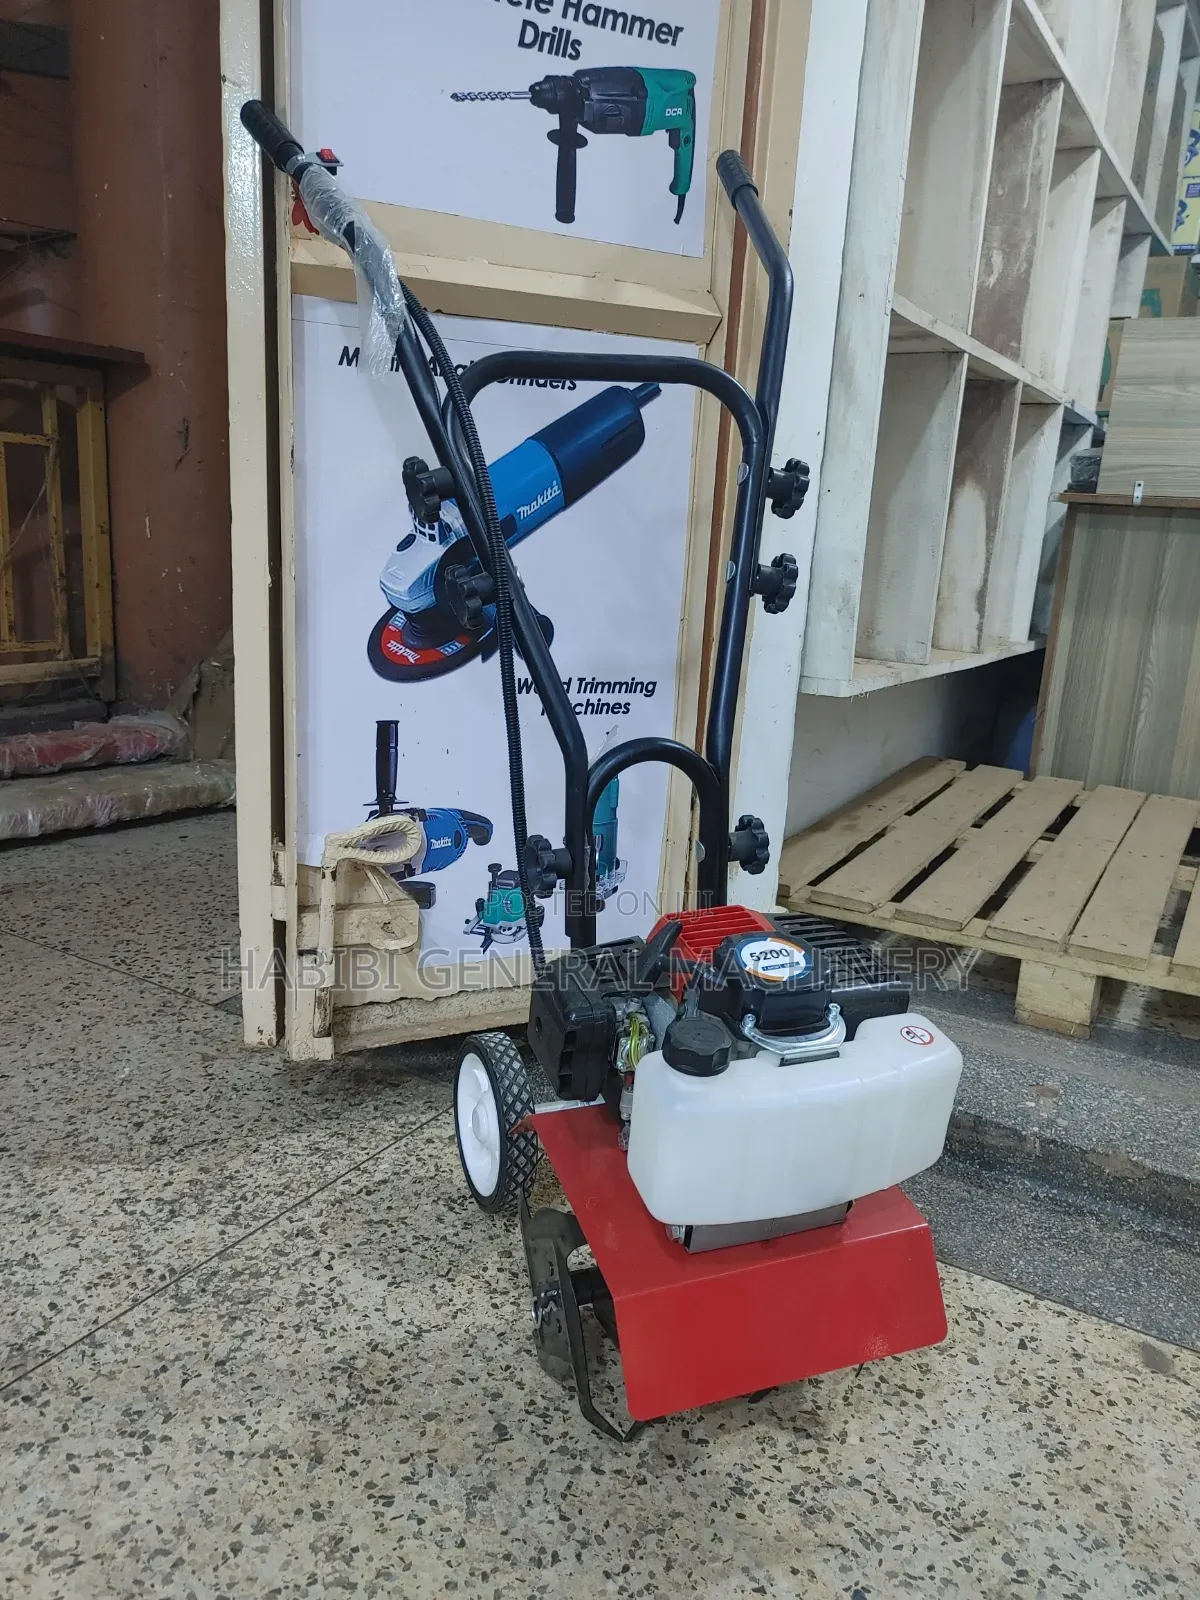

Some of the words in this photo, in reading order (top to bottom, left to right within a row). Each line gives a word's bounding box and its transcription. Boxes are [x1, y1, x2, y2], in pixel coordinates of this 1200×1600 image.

[561, 0, 684, 47] Hammer
[517, 18, 583, 61] Drills
[665, 107, 683, 117] DCA
[517, 677, 572, 695] Wd
[576, 676, 657, 698] Trimming
[540, 698, 631, 716] chines
[749, 948, 791, 962] 5200
